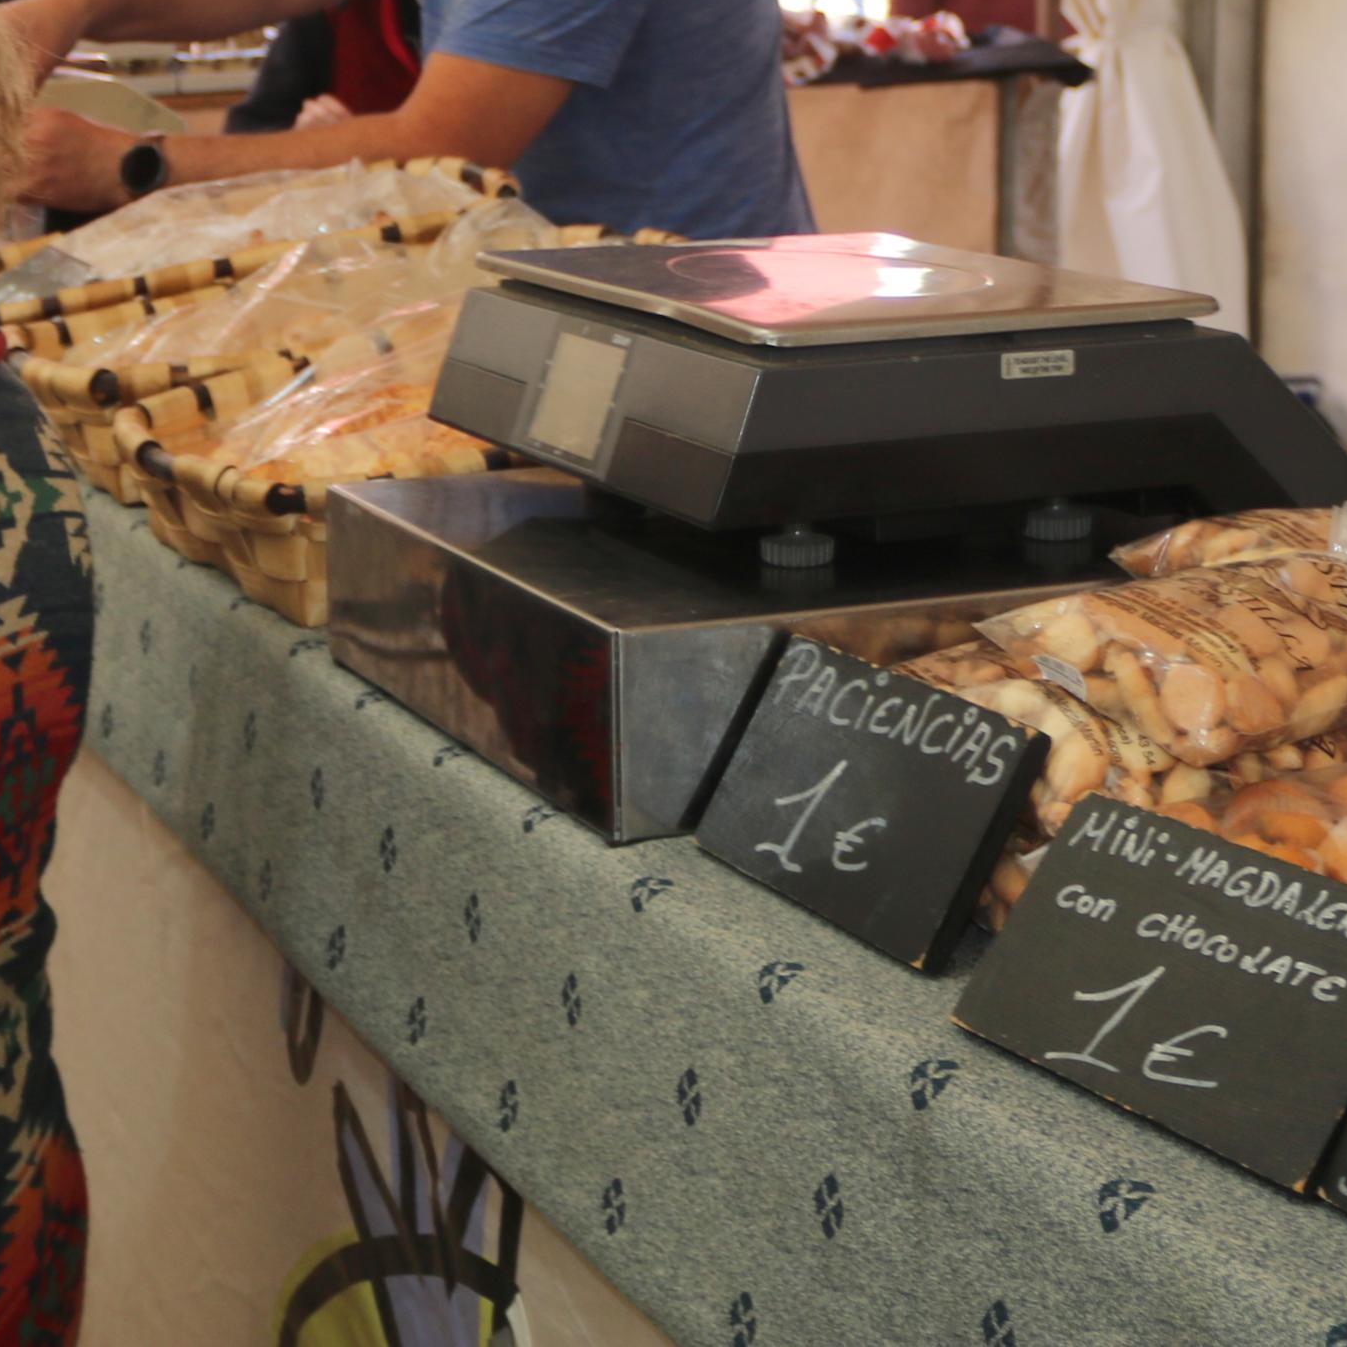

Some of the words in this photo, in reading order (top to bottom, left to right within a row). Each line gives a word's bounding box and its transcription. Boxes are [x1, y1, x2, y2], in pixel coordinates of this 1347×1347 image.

[754, 759, 849, 873] 1
[831, 817, 888, 872] €
[1045, 964, 1166, 1073] 1
[1141, 1023, 1228, 1089] €
